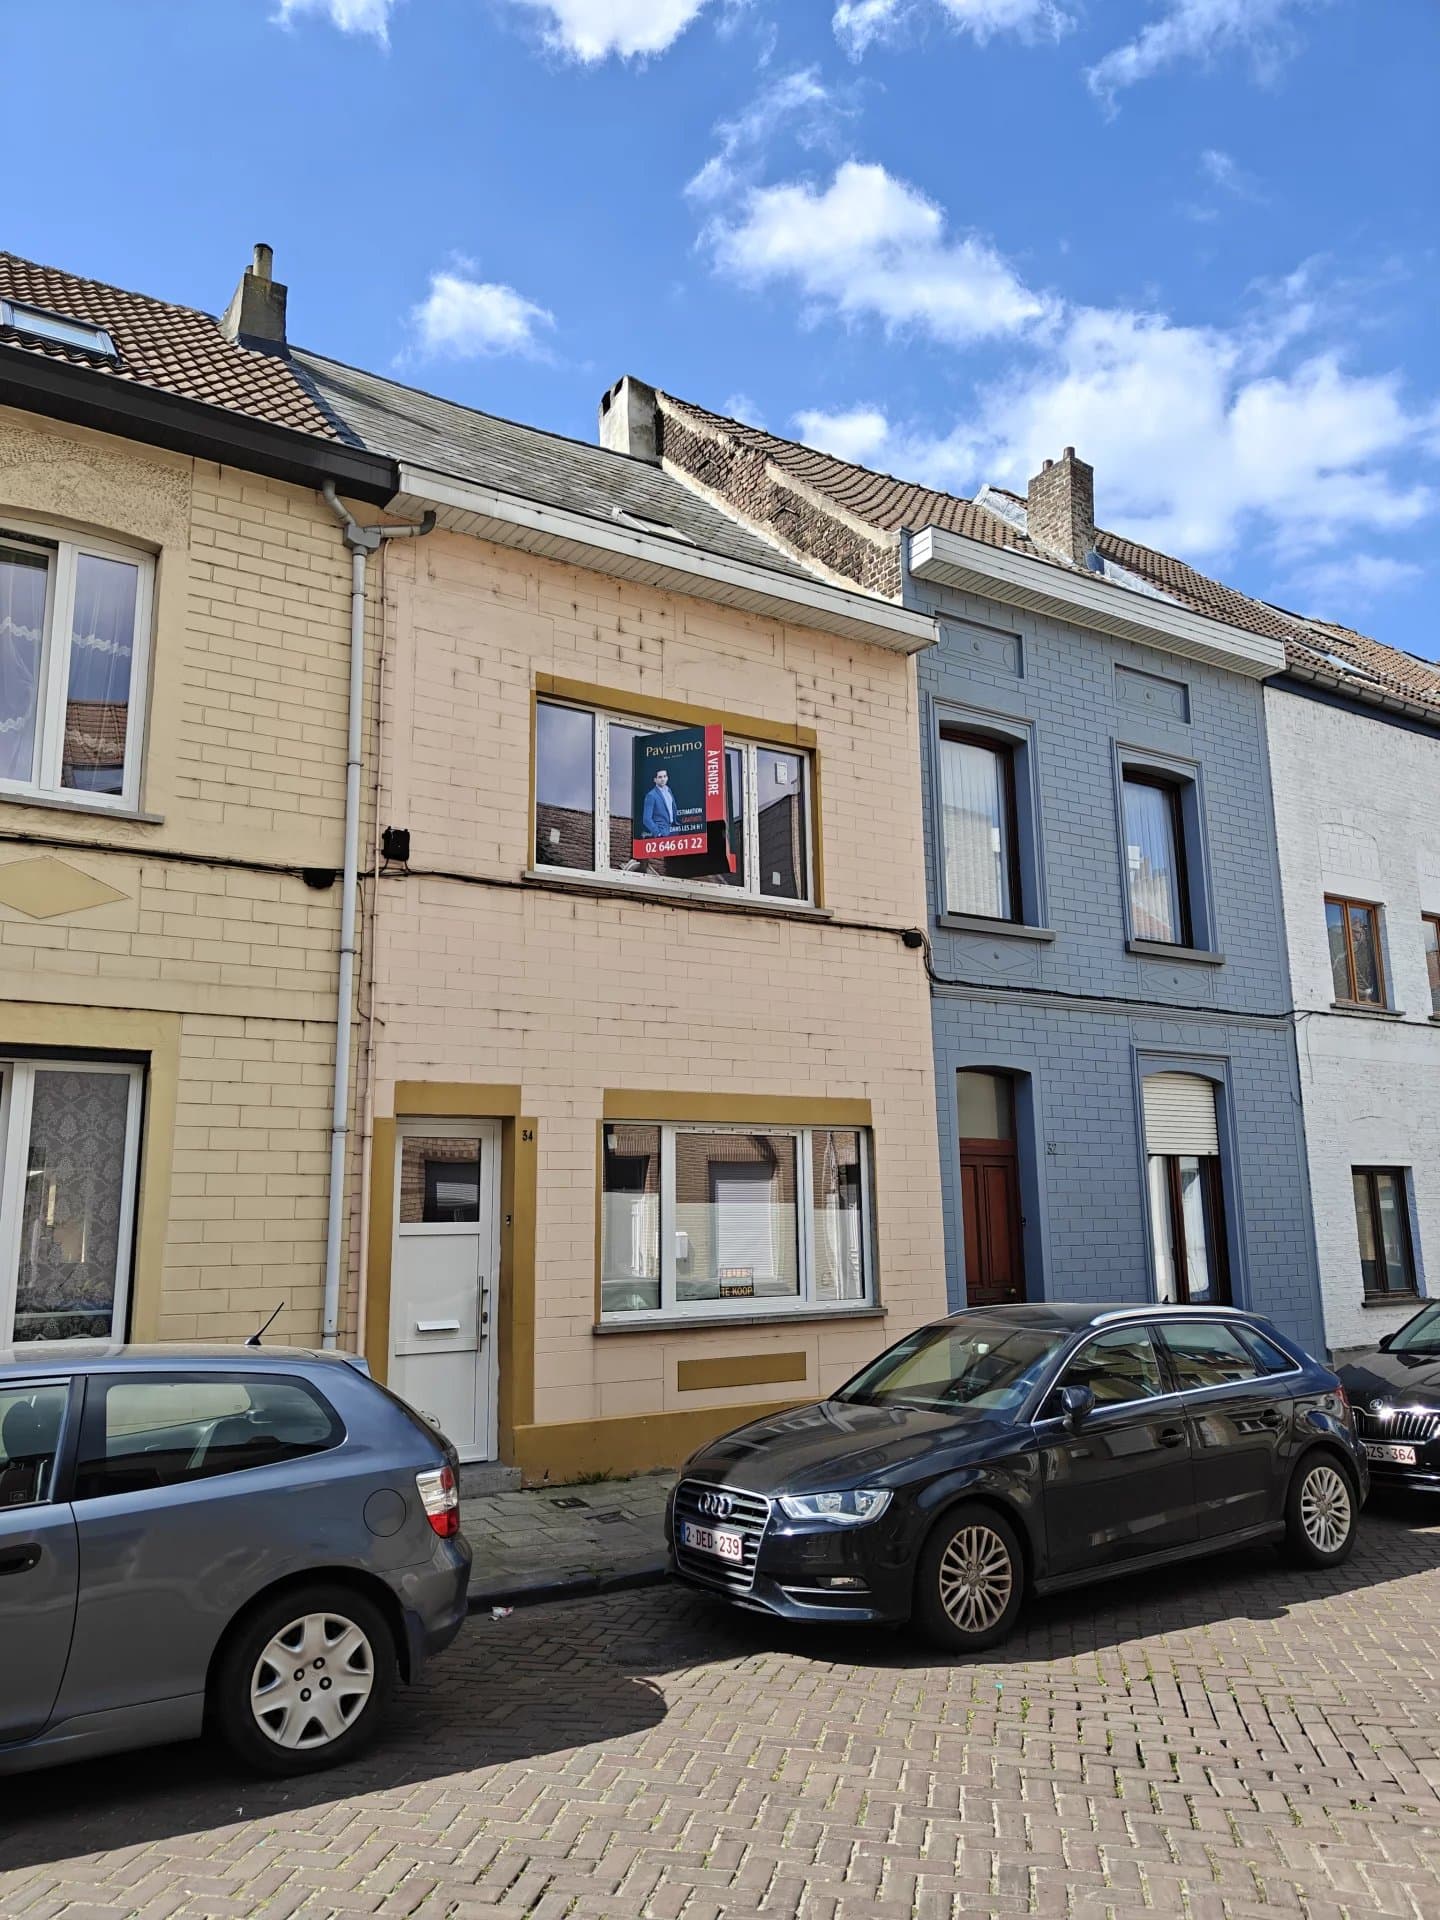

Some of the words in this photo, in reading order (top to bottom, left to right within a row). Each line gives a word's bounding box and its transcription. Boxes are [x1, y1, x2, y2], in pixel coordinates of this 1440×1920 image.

[646, 741, 702, 757] Pavimmo
[708, 759, 719, 796] VENDRE
[645, 843, 657, 853] 02
[658, 840, 675, 852] 646
[678, 839, 688, 850] 61
[691, 837, 703, 849] 22
[522, 1130, 533, 1142] 34
[721, 1288, 730, 1296] TE
[732, 1286, 753, 1296] KOOP
